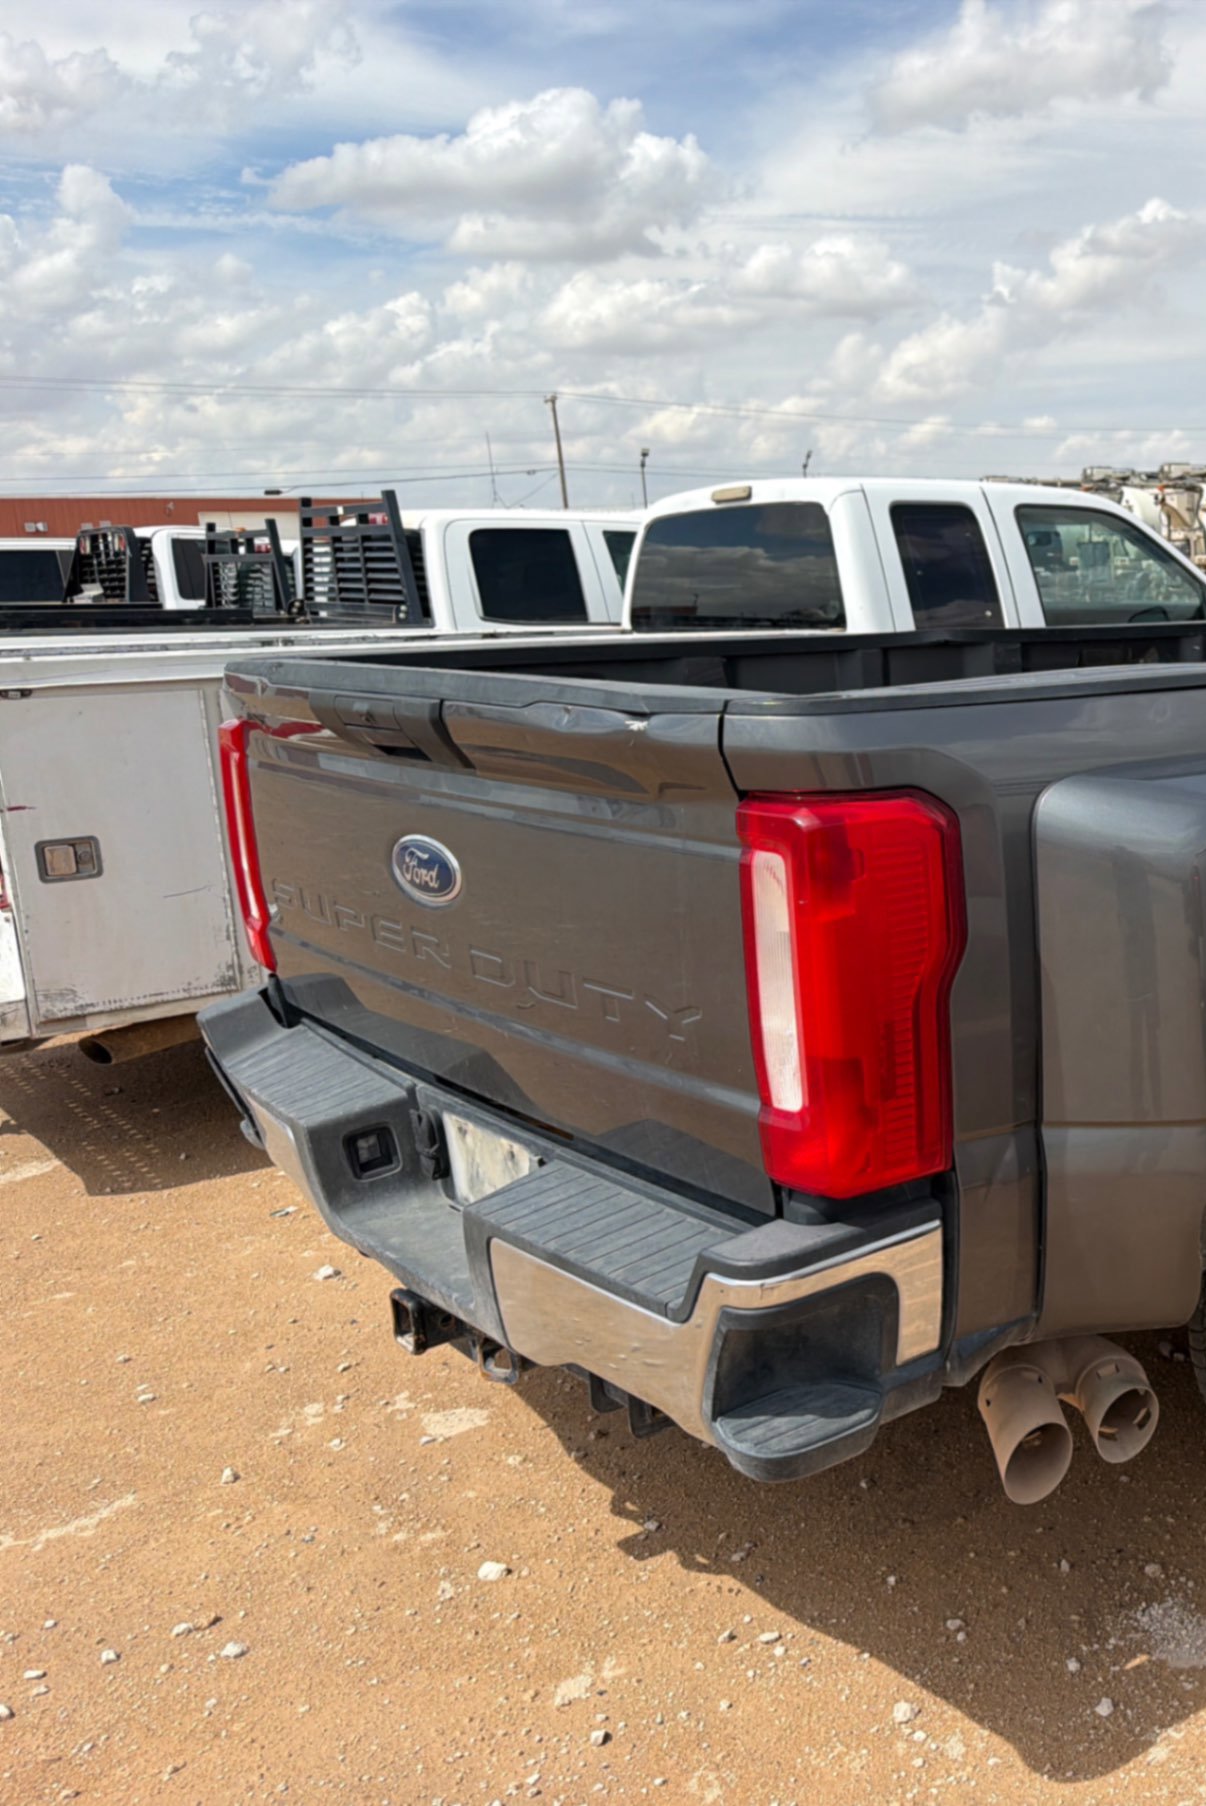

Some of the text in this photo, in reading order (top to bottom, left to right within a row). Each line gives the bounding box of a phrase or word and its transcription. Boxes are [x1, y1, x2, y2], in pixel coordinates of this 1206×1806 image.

[402, 846, 442, 890] Ford
[272, 878, 703, 1042] SUPER DUTY
